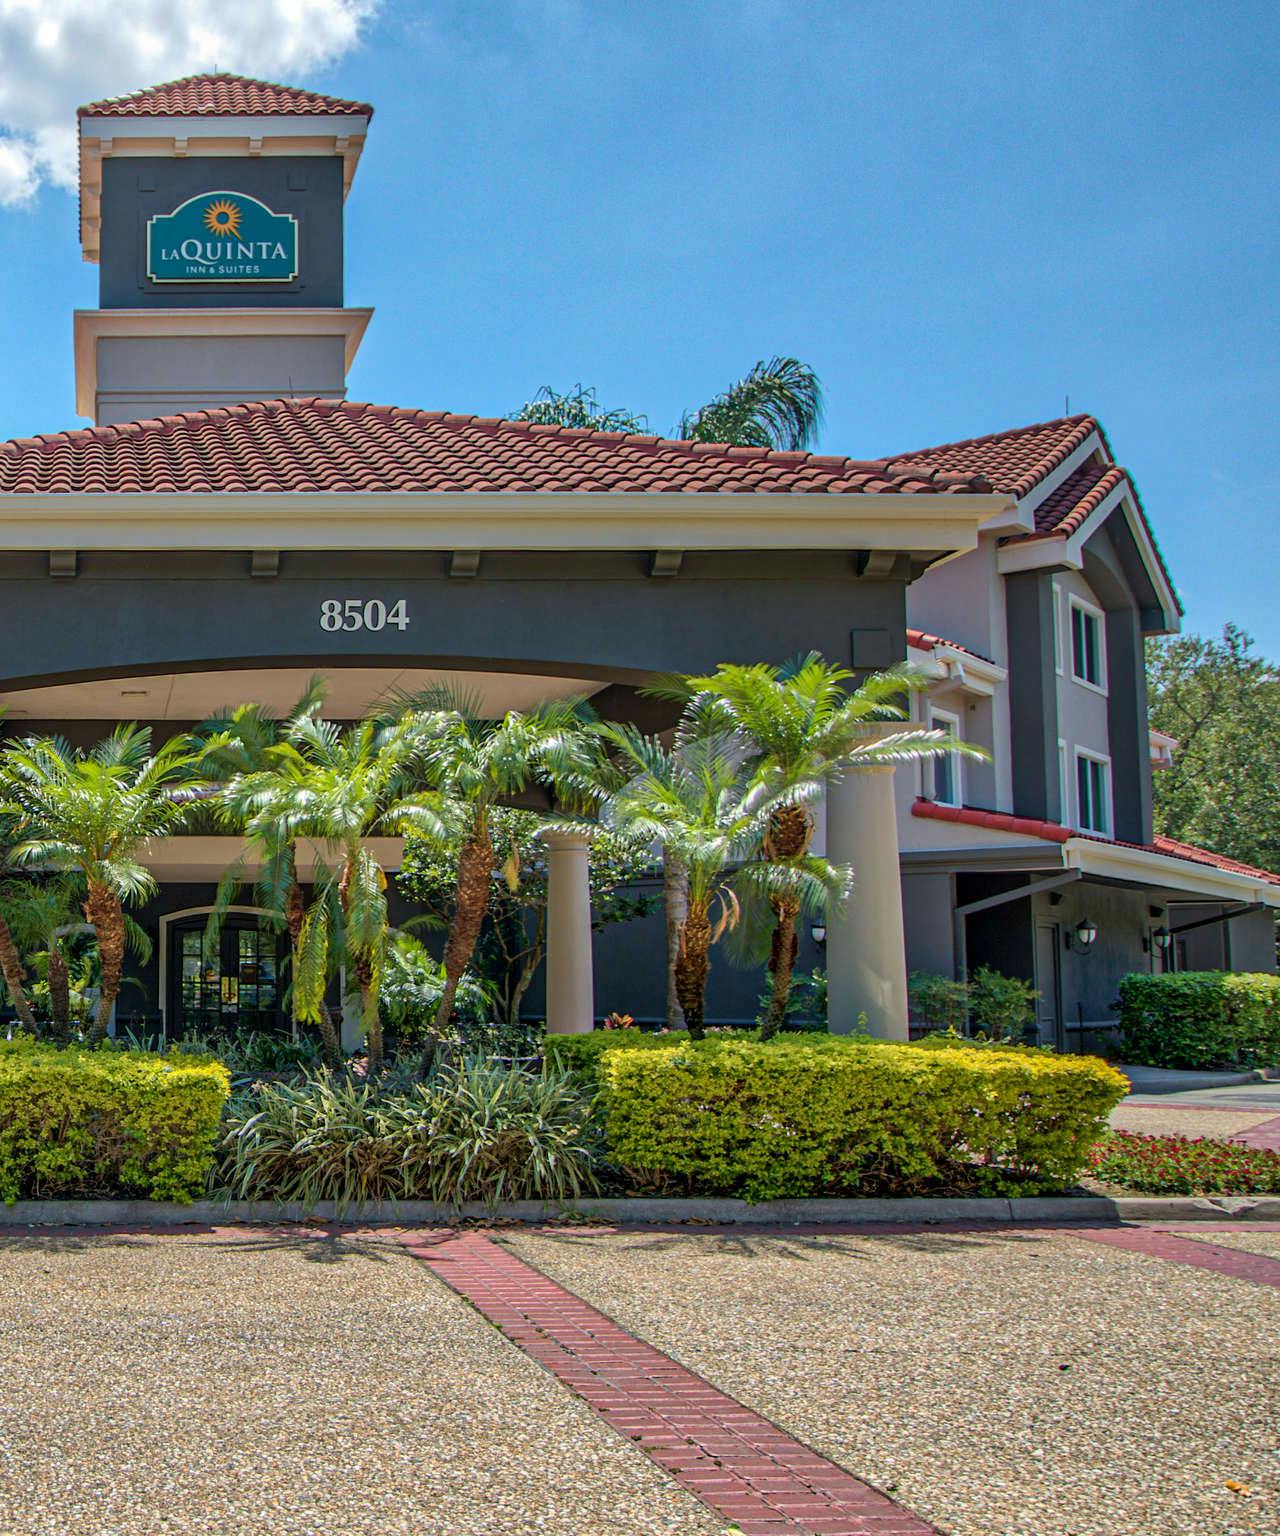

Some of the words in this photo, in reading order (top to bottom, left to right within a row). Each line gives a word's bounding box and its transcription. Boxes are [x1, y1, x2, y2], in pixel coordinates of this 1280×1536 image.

[161, 249, 180, 260] LA
[180, 239, 288, 265] QUINTA
[186, 266, 206, 274] INN
[209, 266, 215, 274] &
[218, 265, 260, 274] SUITES
[320, 599, 410, 631] 8504
